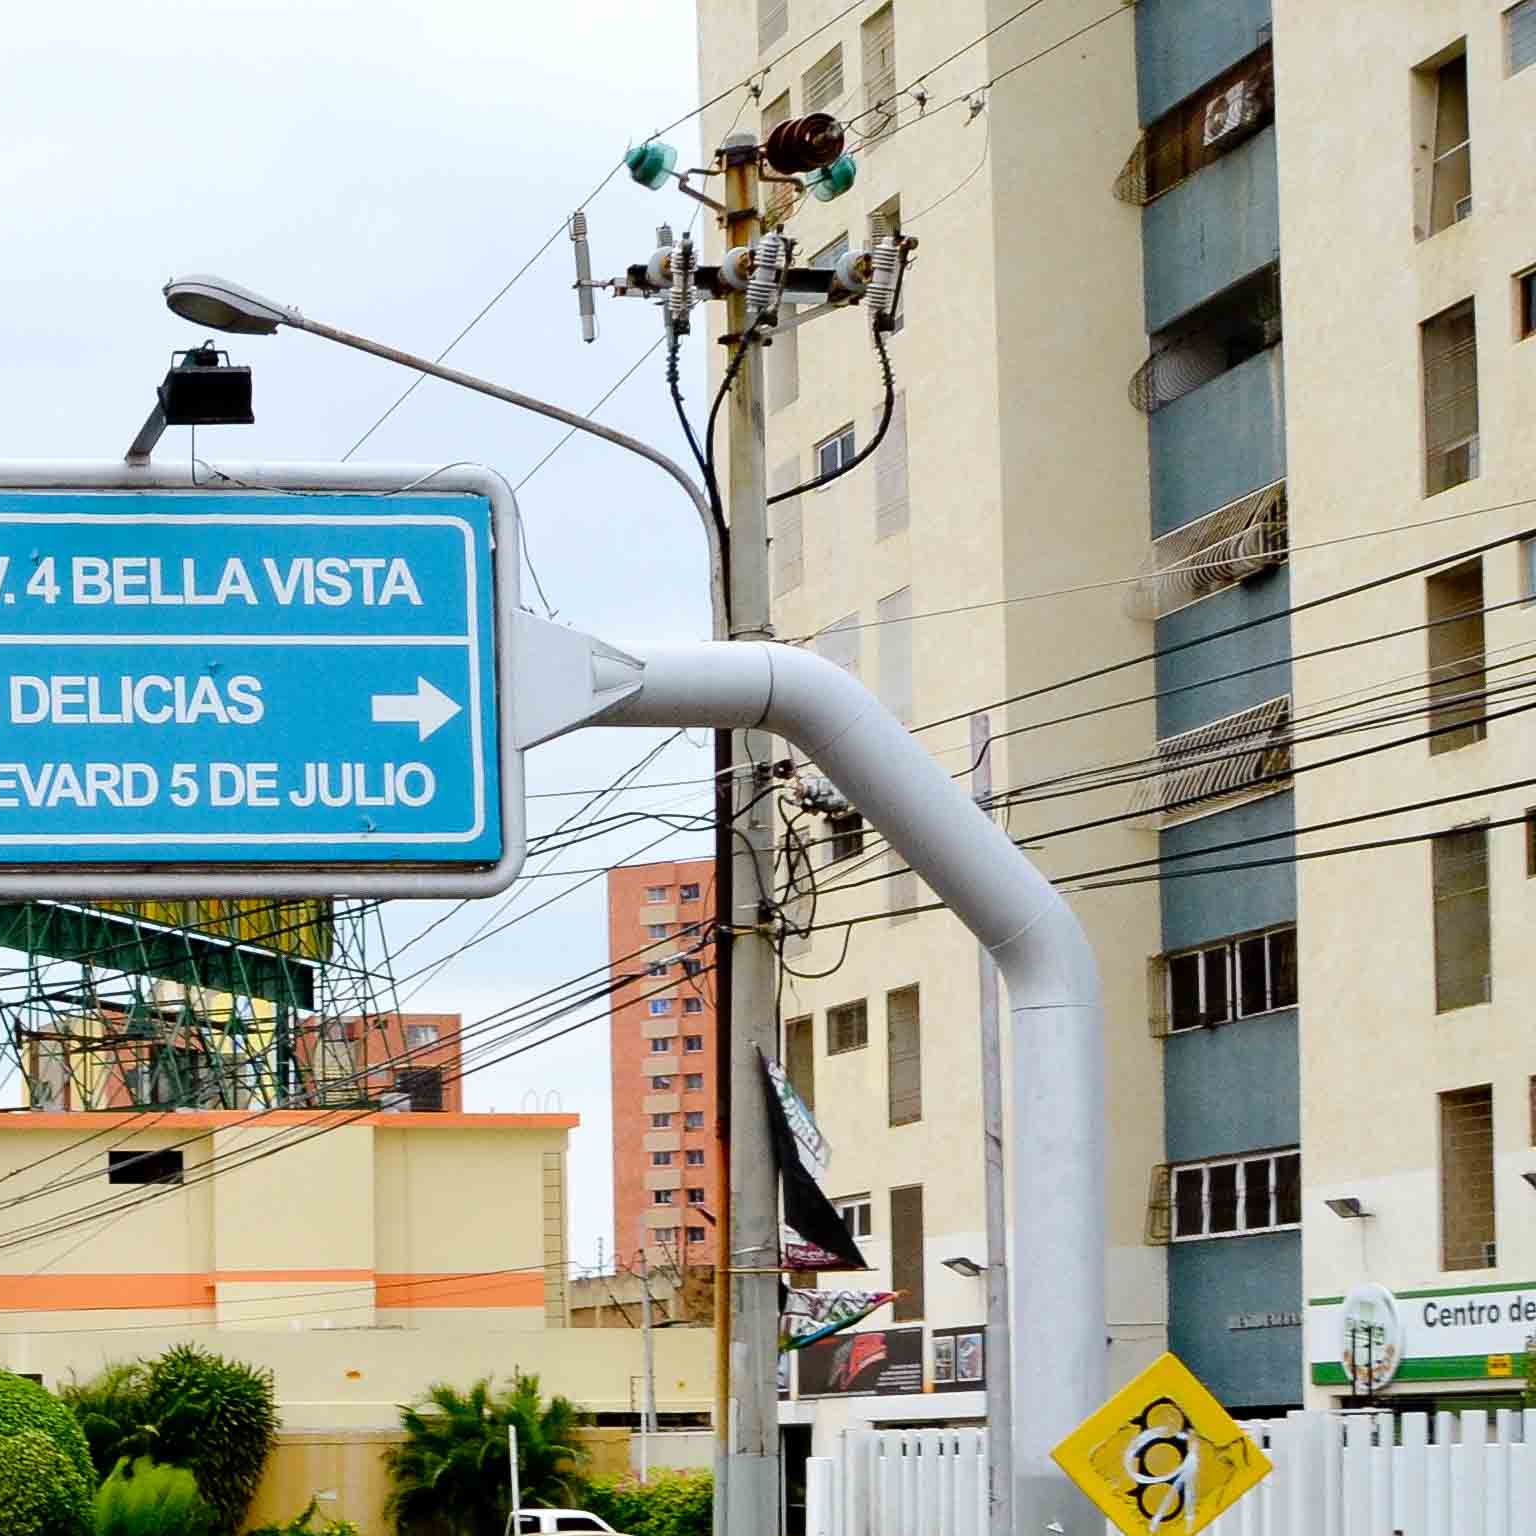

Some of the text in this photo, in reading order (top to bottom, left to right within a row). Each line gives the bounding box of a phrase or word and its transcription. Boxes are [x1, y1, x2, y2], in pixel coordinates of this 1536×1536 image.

[27, 556, 59, 605] 4
[73, 556, 257, 605] BELLA
[263, 556, 422, 605] VISTA
[10, 675, 265, 724] DELICIAS
[170, 762, 199, 808] 5
[211, 762, 278, 808] DE
[289, 762, 435, 808] JULIO
[1423, 1301, 1500, 1328] Centro
